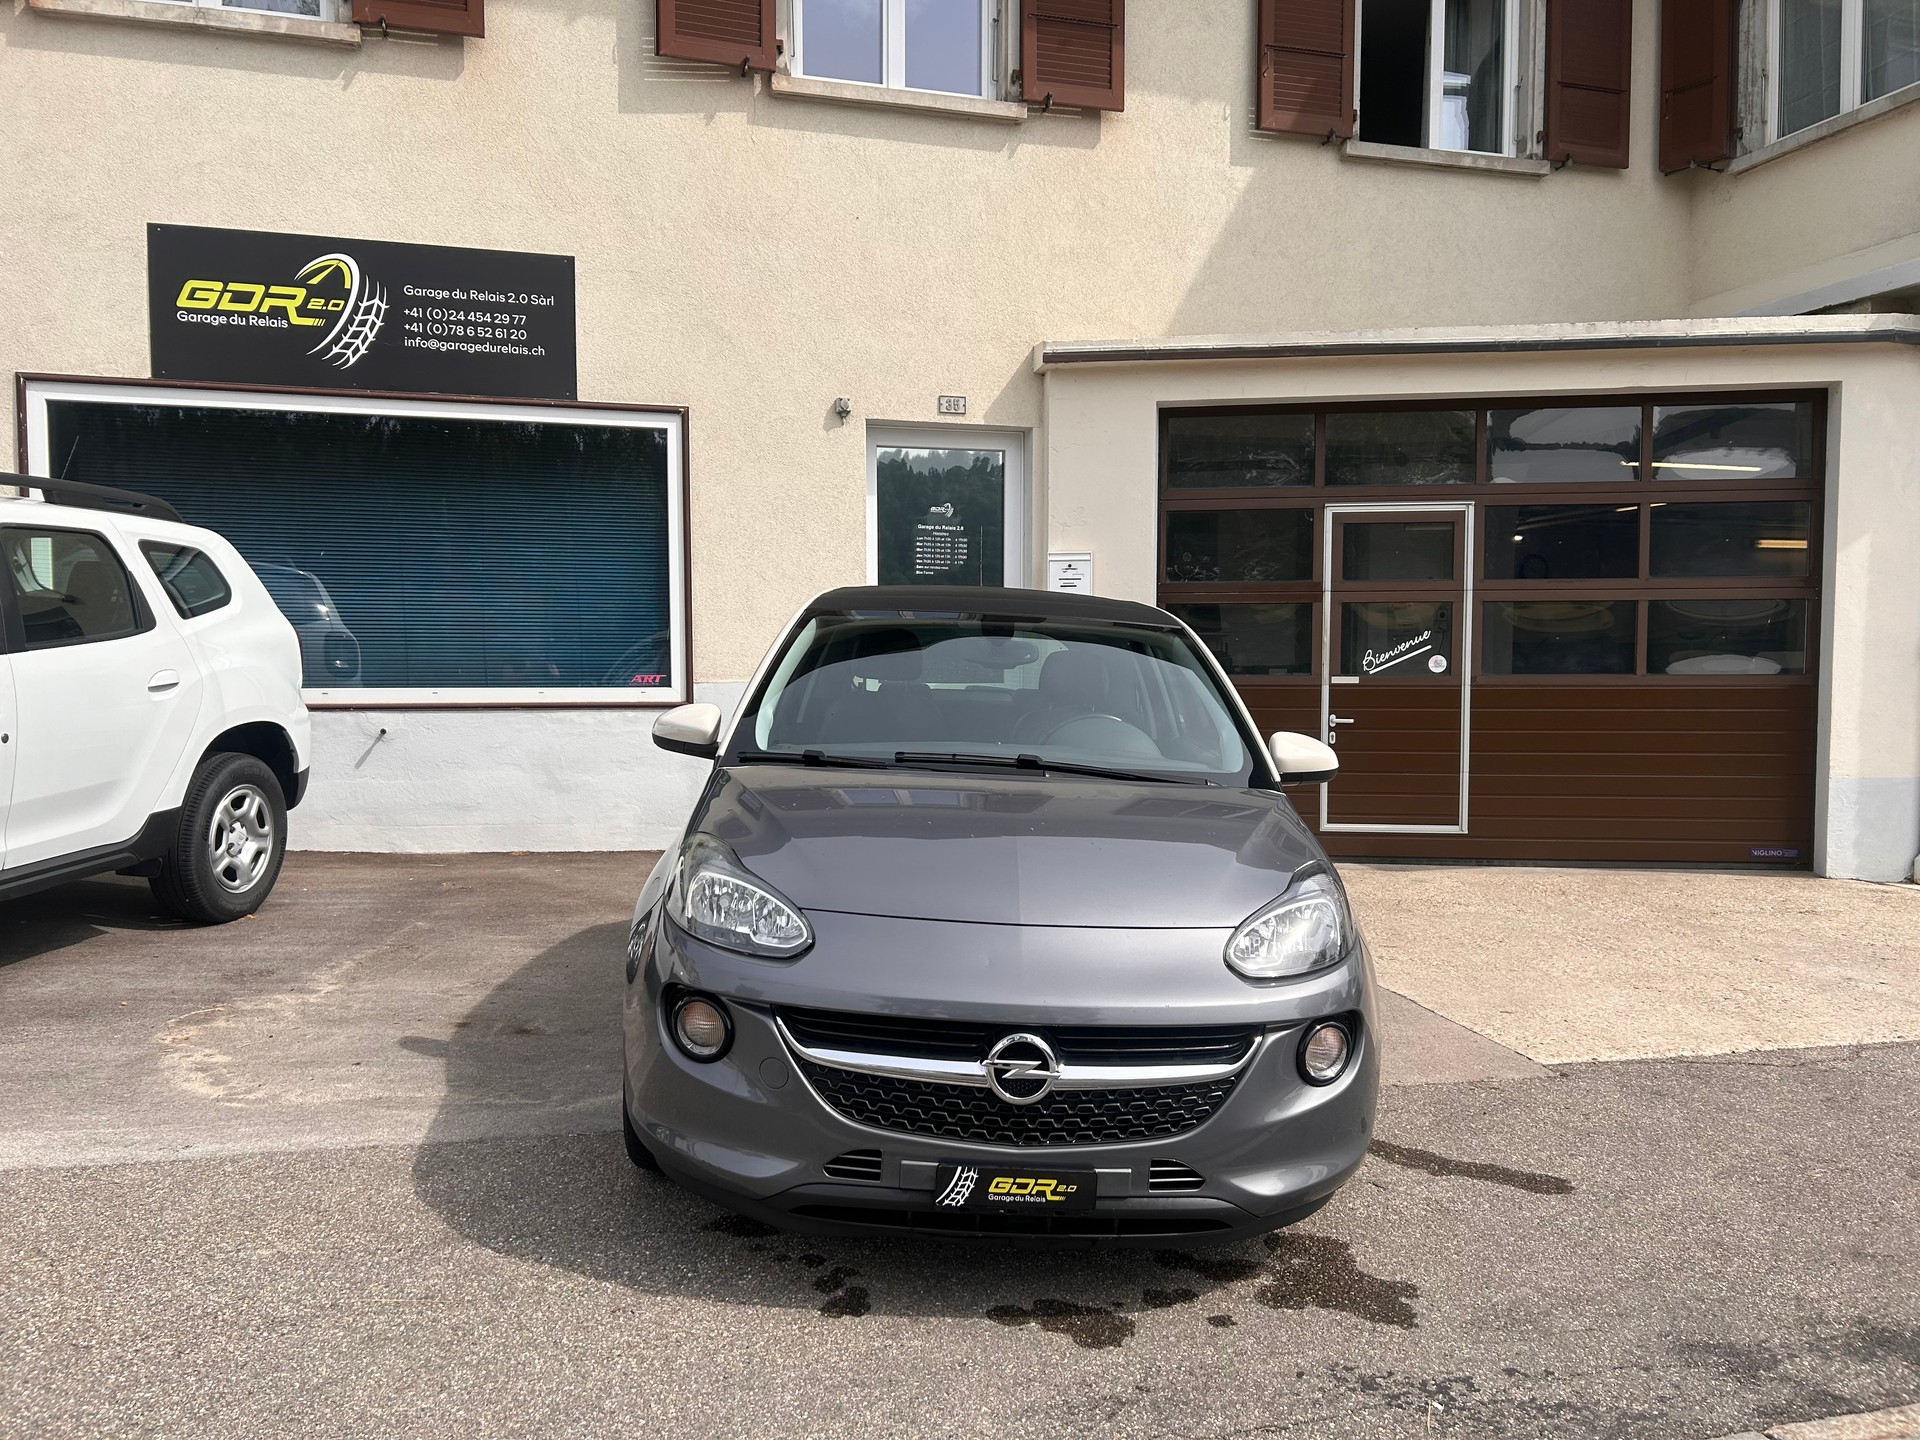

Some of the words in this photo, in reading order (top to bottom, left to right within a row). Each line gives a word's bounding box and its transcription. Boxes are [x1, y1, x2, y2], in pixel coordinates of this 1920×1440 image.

[176, 279, 314, 326] GDR
[306, 298, 345, 311] 2.0
[403, 285, 450, 300] Garage
[452, 289, 467, 300] du
[470, 290, 506, 303] Relais
[507, 293, 528, 304] 2.0
[530, 294, 554, 306] Sàrl
[176, 310, 227, 326] Garage
[229, 313, 246, 326] du
[249, 316, 289, 329] Relais
[403, 307, 423, 318] +41
[467, 312, 492, 323] 454
[493, 314, 510, 324] 29
[511, 315, 527, 325] 77
[403, 323, 423, 333] +41
[495, 328, 507, 339] 61
[509, 329, 527, 340] 20
[404, 336, 545, 356] info@garagedurelais.ch
[945, 398, 961, 412] 35
[1362, 629, 1432, 671] Bienvenue
[630, 674, 667, 683] ART
[1751, 849, 1783, 857] VIGLINO
[988, 1177, 1060, 1201] GDR
[988, 1193, 1014, 1202] Garage
[1015, 1194, 1024, 1202] du
[1025, 1195, 1046, 1203] Relais
